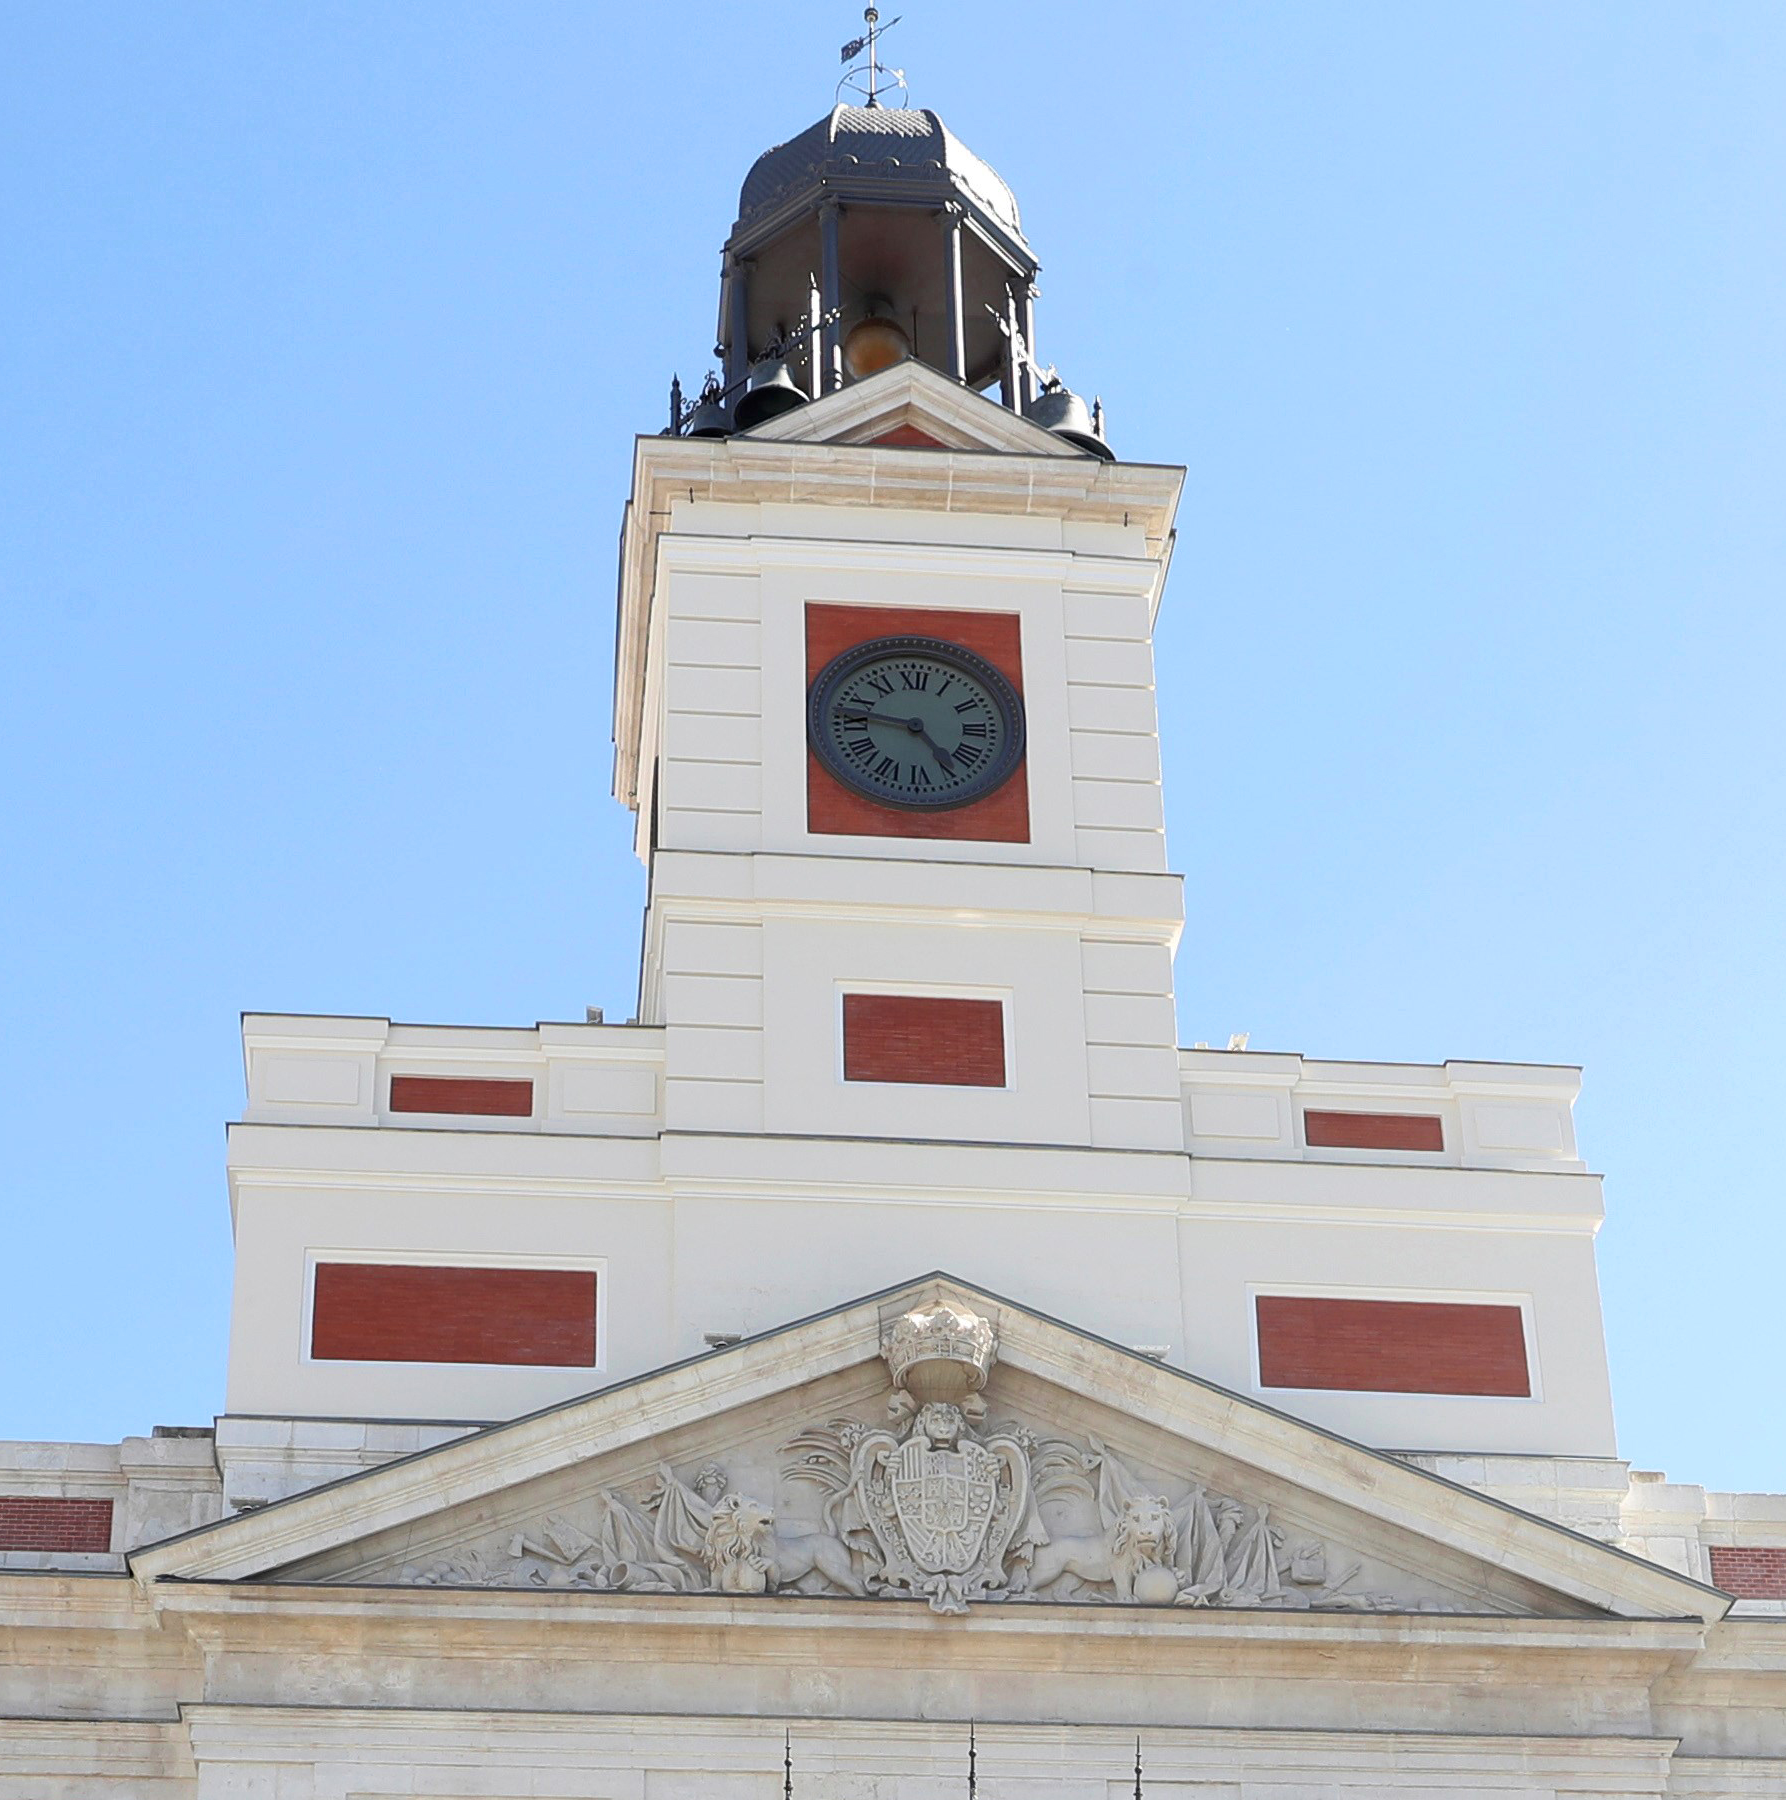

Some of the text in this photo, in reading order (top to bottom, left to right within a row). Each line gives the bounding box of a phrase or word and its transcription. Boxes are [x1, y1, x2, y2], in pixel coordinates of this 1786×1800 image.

[868, 674, 894, 698] XI
[900, 670, 930, 691] XII
[954, 698, 978, 714] II
[962, 722, 987, 738] III
